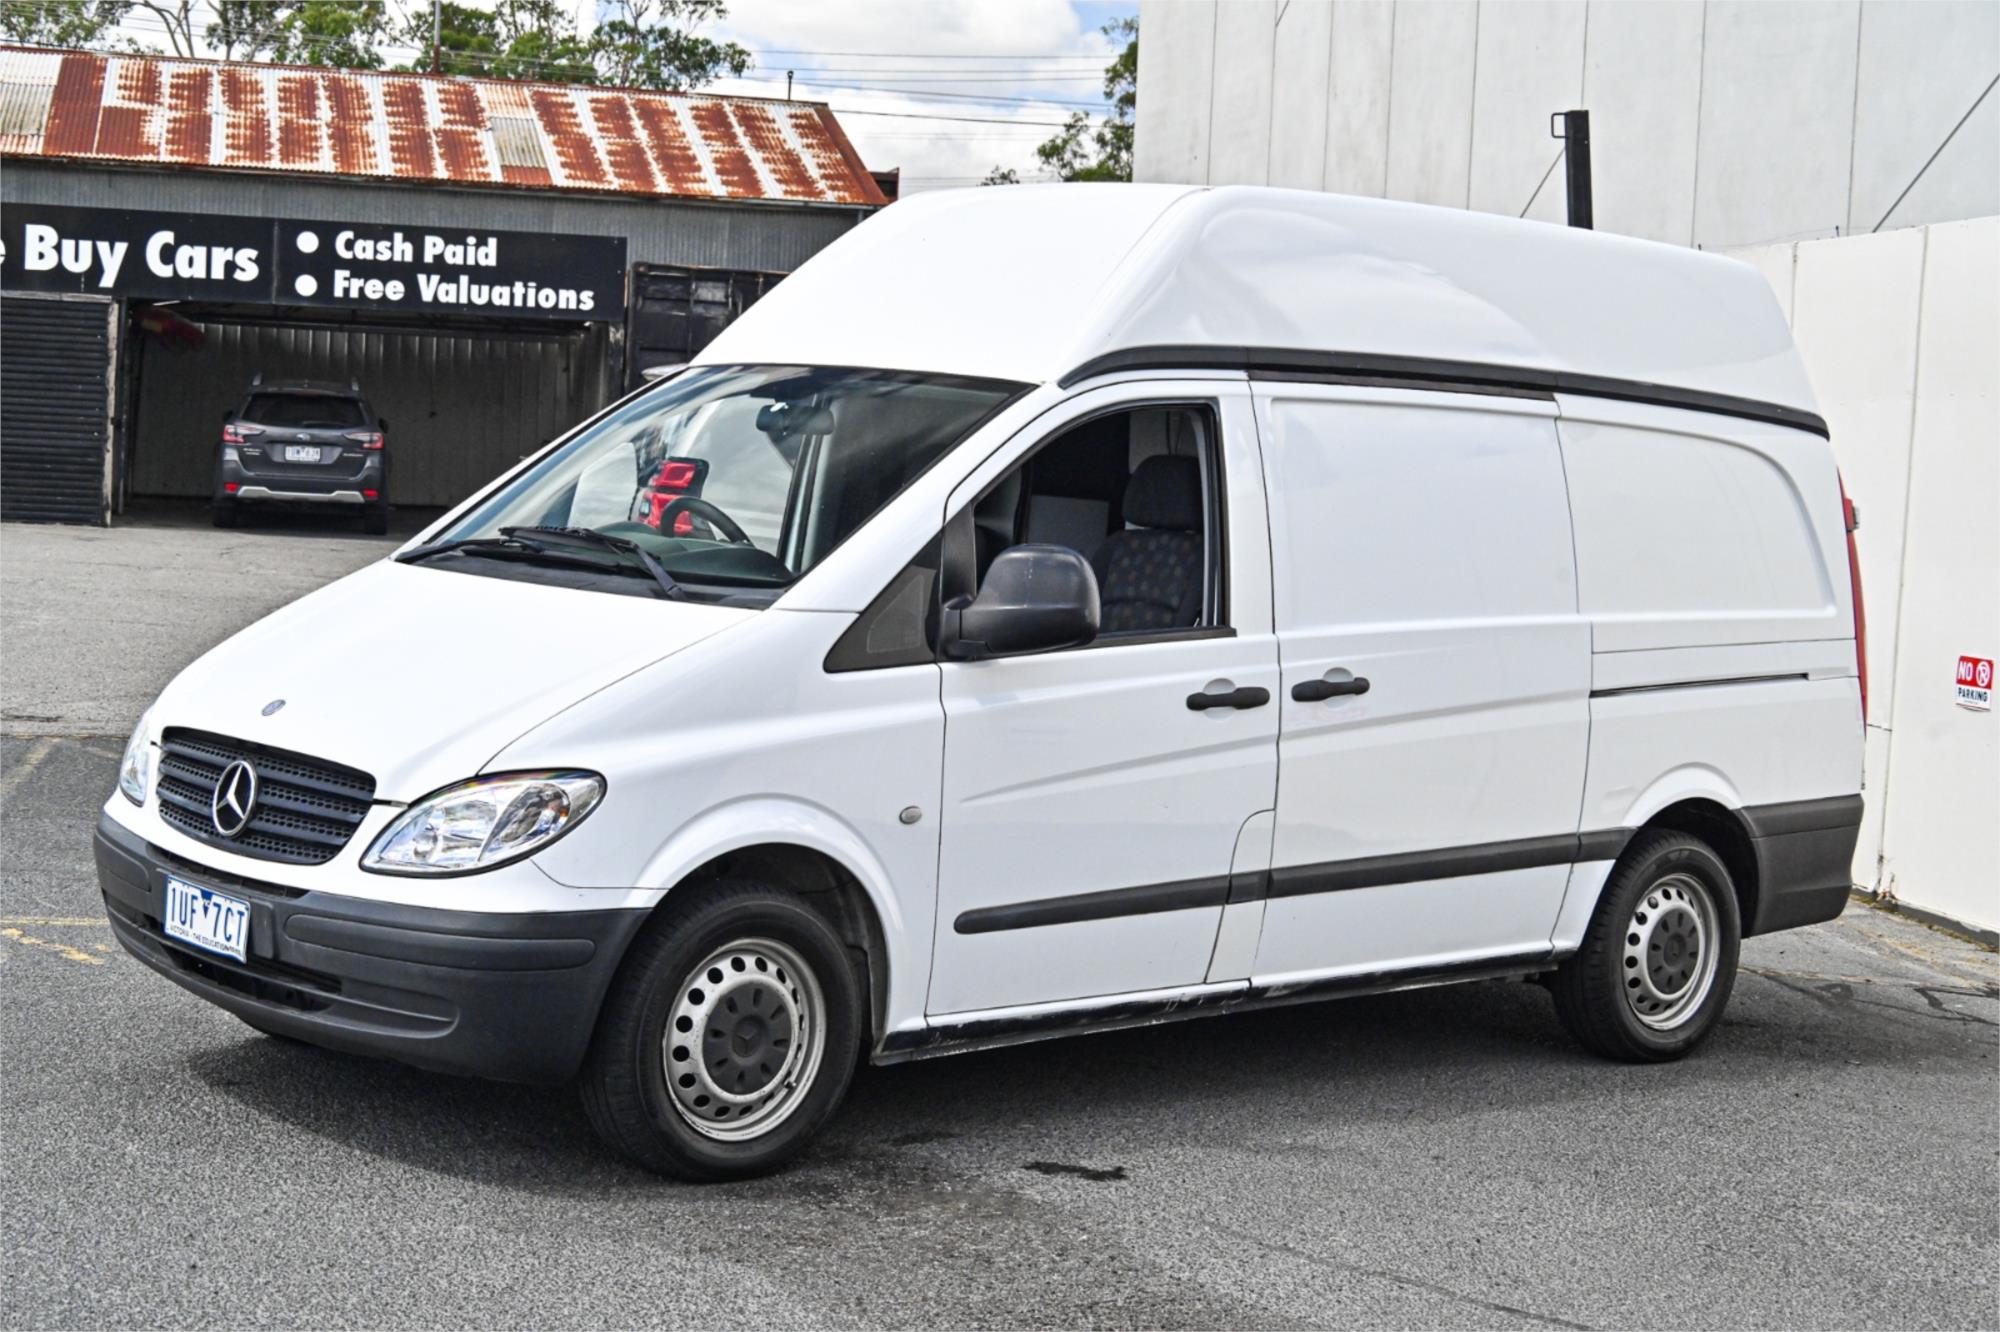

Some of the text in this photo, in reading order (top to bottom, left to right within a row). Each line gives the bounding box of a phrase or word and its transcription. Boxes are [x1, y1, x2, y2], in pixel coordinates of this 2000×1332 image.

[24, 223, 129, 289] Buy
[145, 230, 260, 282] Cars
[335, 230, 498, 267] Cash Paid
[333, 269, 595, 311] Free Valuations
[1959, 661, 1973, 681] NO
[1958, 687, 1988, 702] PARKING
[172, 887, 245, 946] 1UF 7CT
